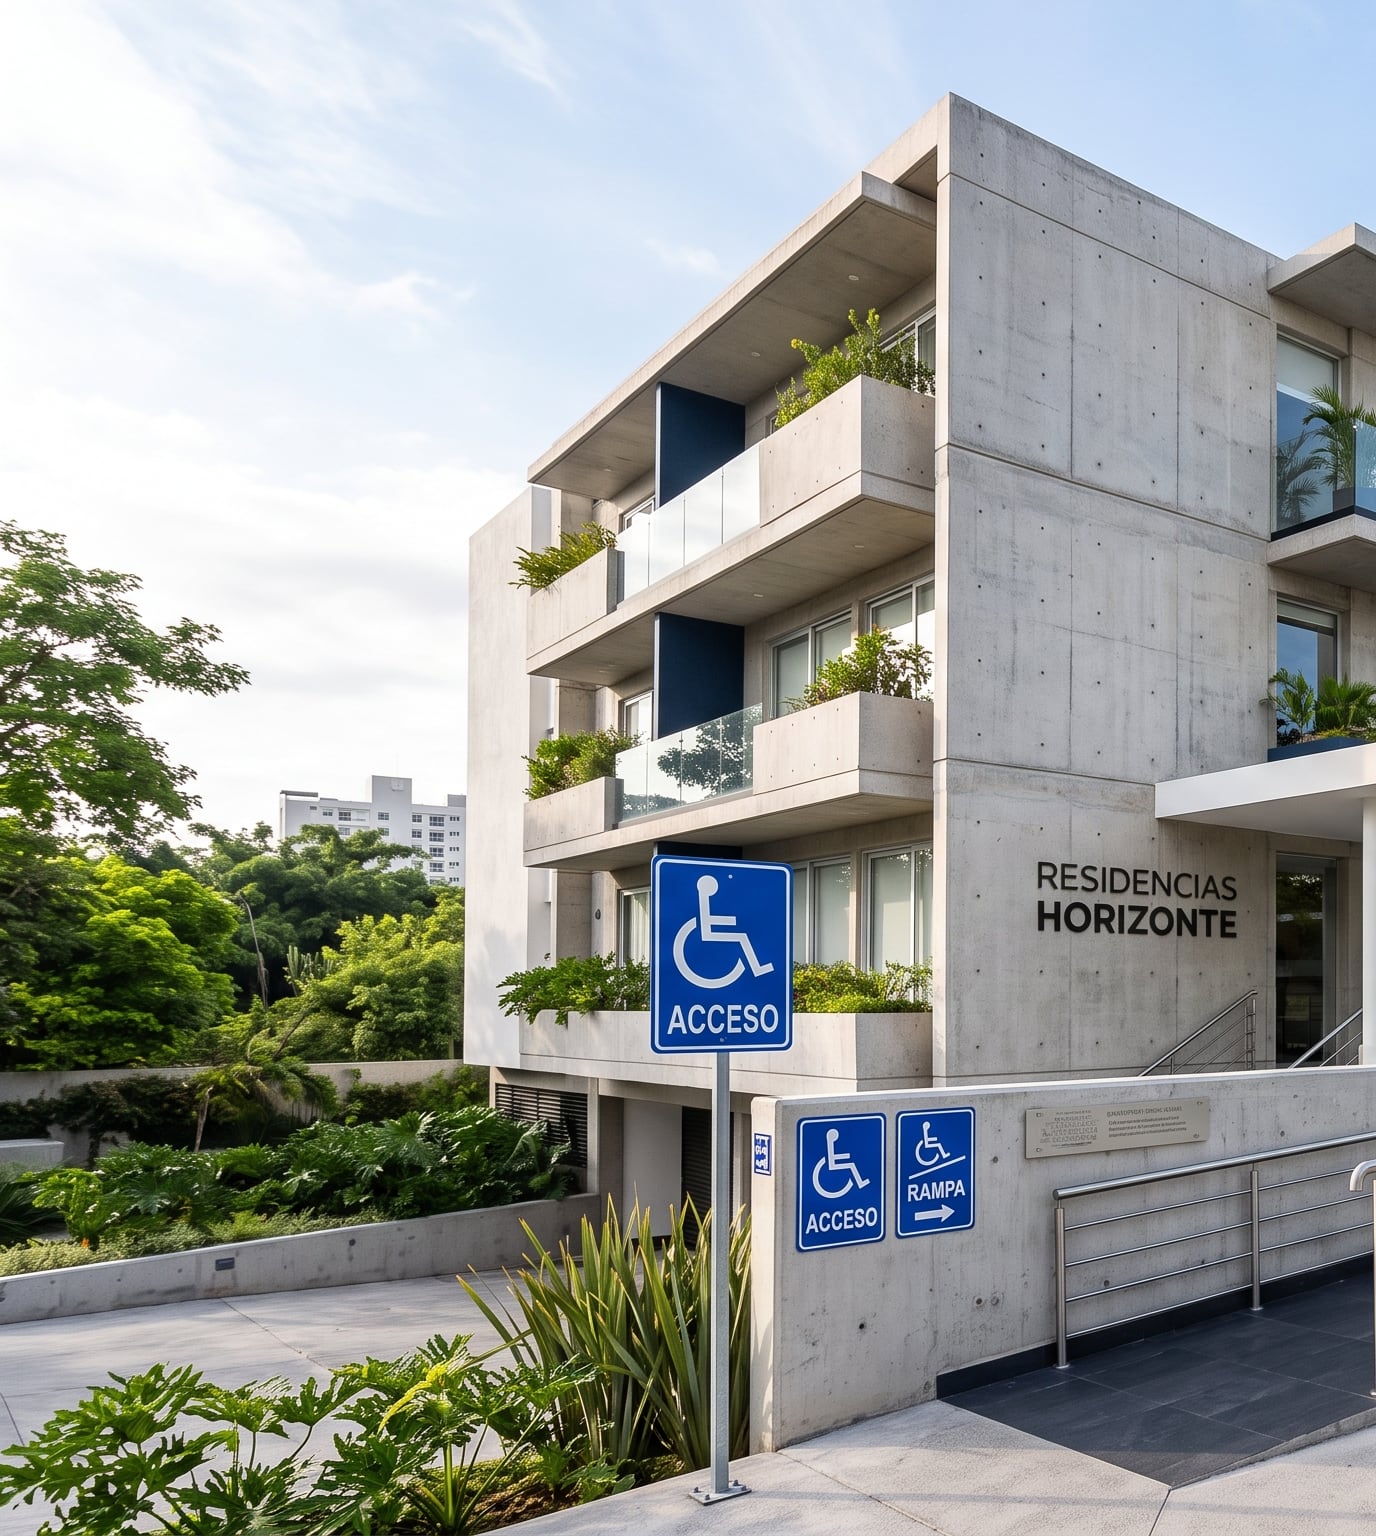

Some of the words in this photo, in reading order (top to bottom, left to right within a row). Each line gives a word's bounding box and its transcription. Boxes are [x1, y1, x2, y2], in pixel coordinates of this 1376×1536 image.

[1037, 861, 1237, 901] RESIDENCIAS
[1037, 900, 1238, 938] HORIZONTE
[667, 1004, 779, 1035] ACCESO
[907, 1180, 966, 1203] RAMPA
[805, 1206, 878, 1234] ACCESO
